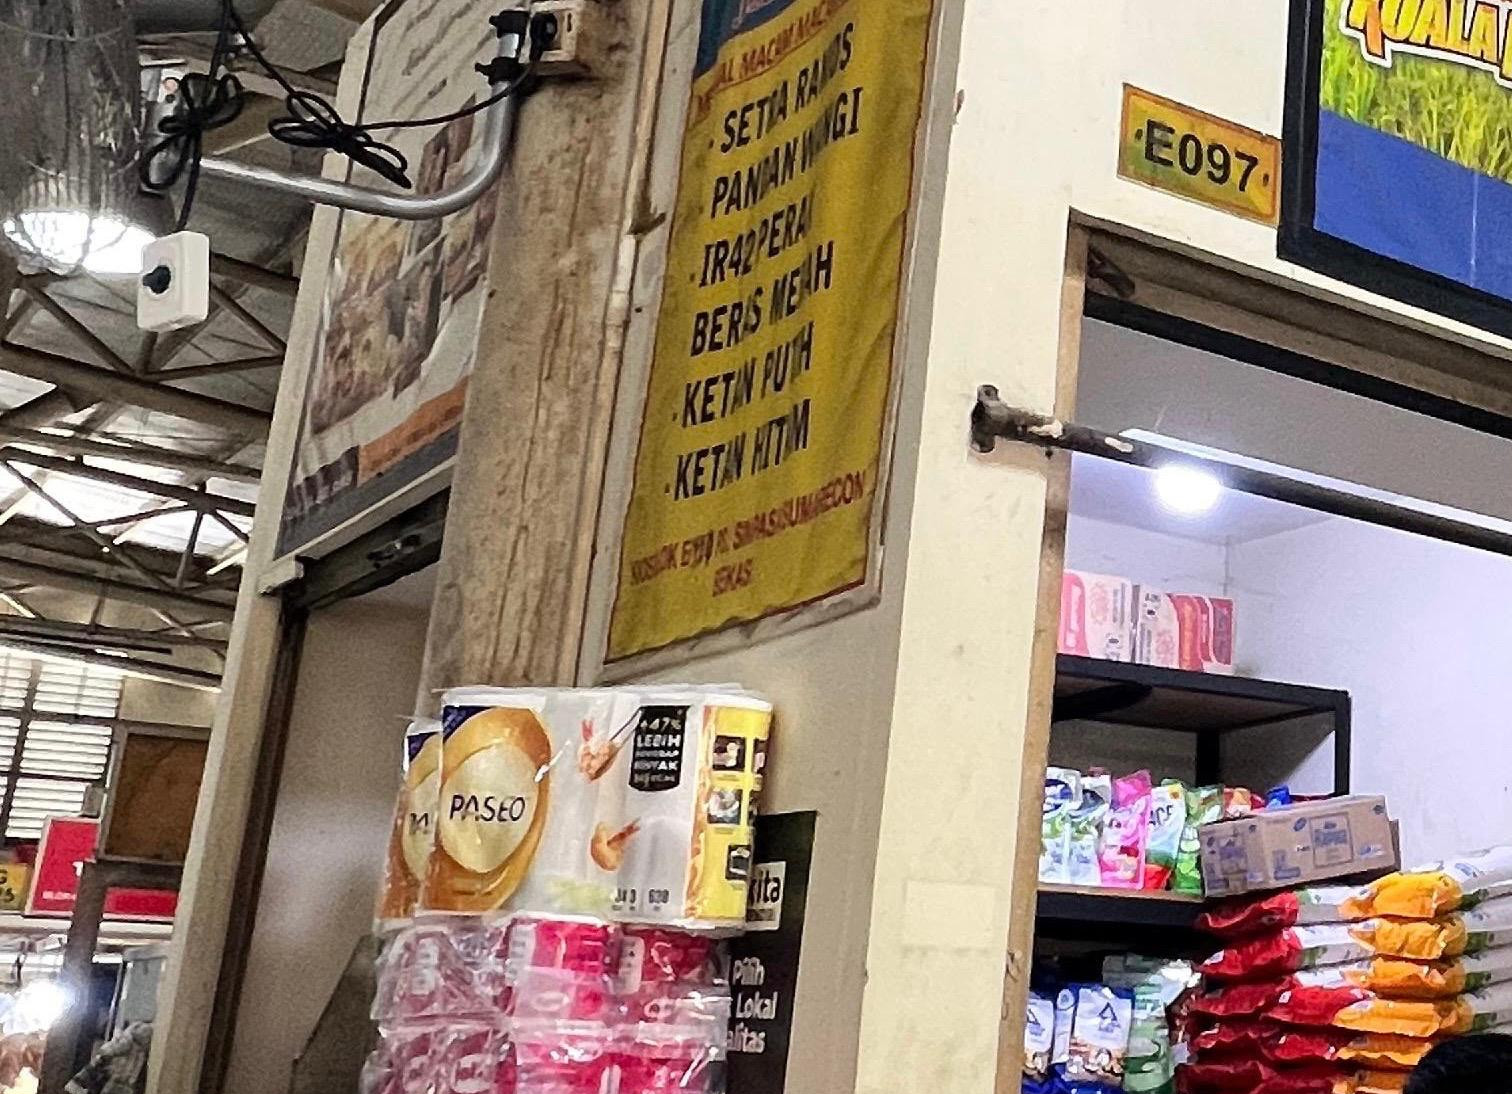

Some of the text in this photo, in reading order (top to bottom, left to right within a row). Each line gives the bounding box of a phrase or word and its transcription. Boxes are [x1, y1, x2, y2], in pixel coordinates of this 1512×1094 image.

[1144, 118, 1259, 193] E097
[636, 734, 682, 748] LEBIH
[448, 794, 528, 823] PASEO
[736, 990, 778, 1020] Lokal
